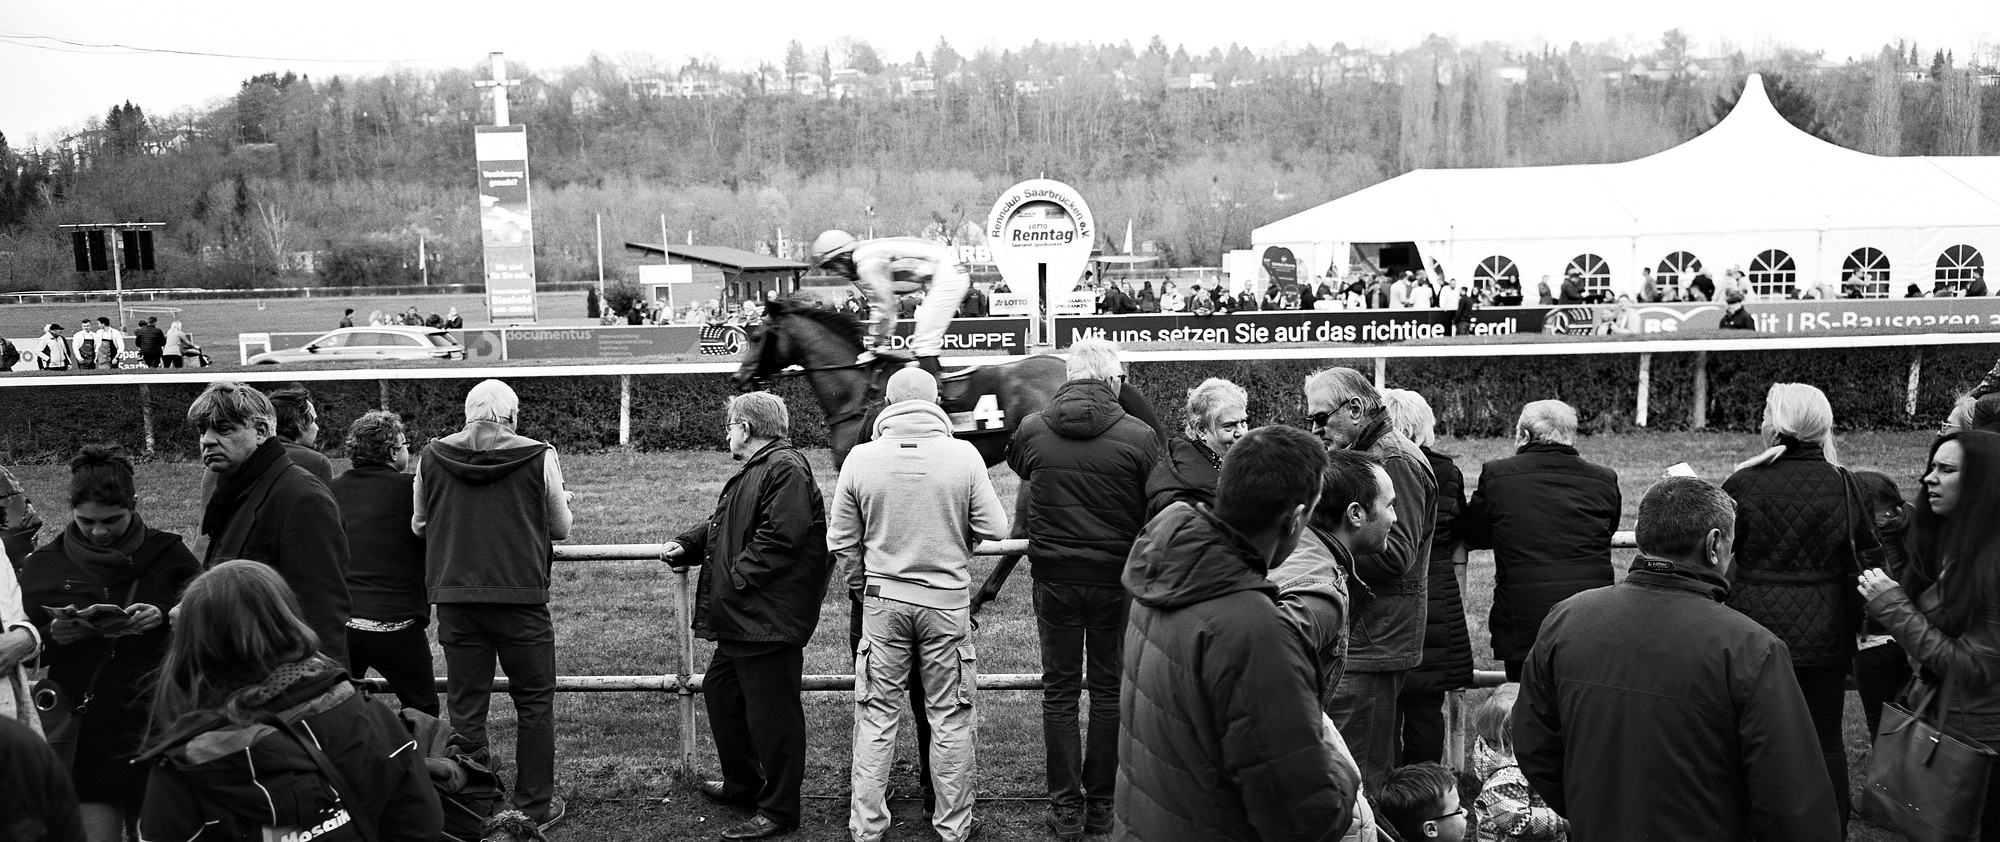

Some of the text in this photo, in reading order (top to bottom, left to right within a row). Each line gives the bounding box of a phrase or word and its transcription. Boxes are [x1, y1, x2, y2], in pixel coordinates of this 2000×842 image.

[991, 188, 1091, 238] Rennclub Saarbrücken e.V.
[1012, 229, 1074, 244] Renntag
[491, 295, 532, 305] Dienhold
[1004, 299, 1028, 307] LOTTO
[506, 330, 592, 341] documentus
[1113, 330, 1151, 343] uns
[1157, 325, 1229, 344] setzen
[1234, 323, 1269, 343] Sie
[1275, 320, 1311, 343] auf
[1315, 320, 1356, 342] das
[1362, 319, 1445, 341] richtige
[973, 394, 1005, 430] 4
